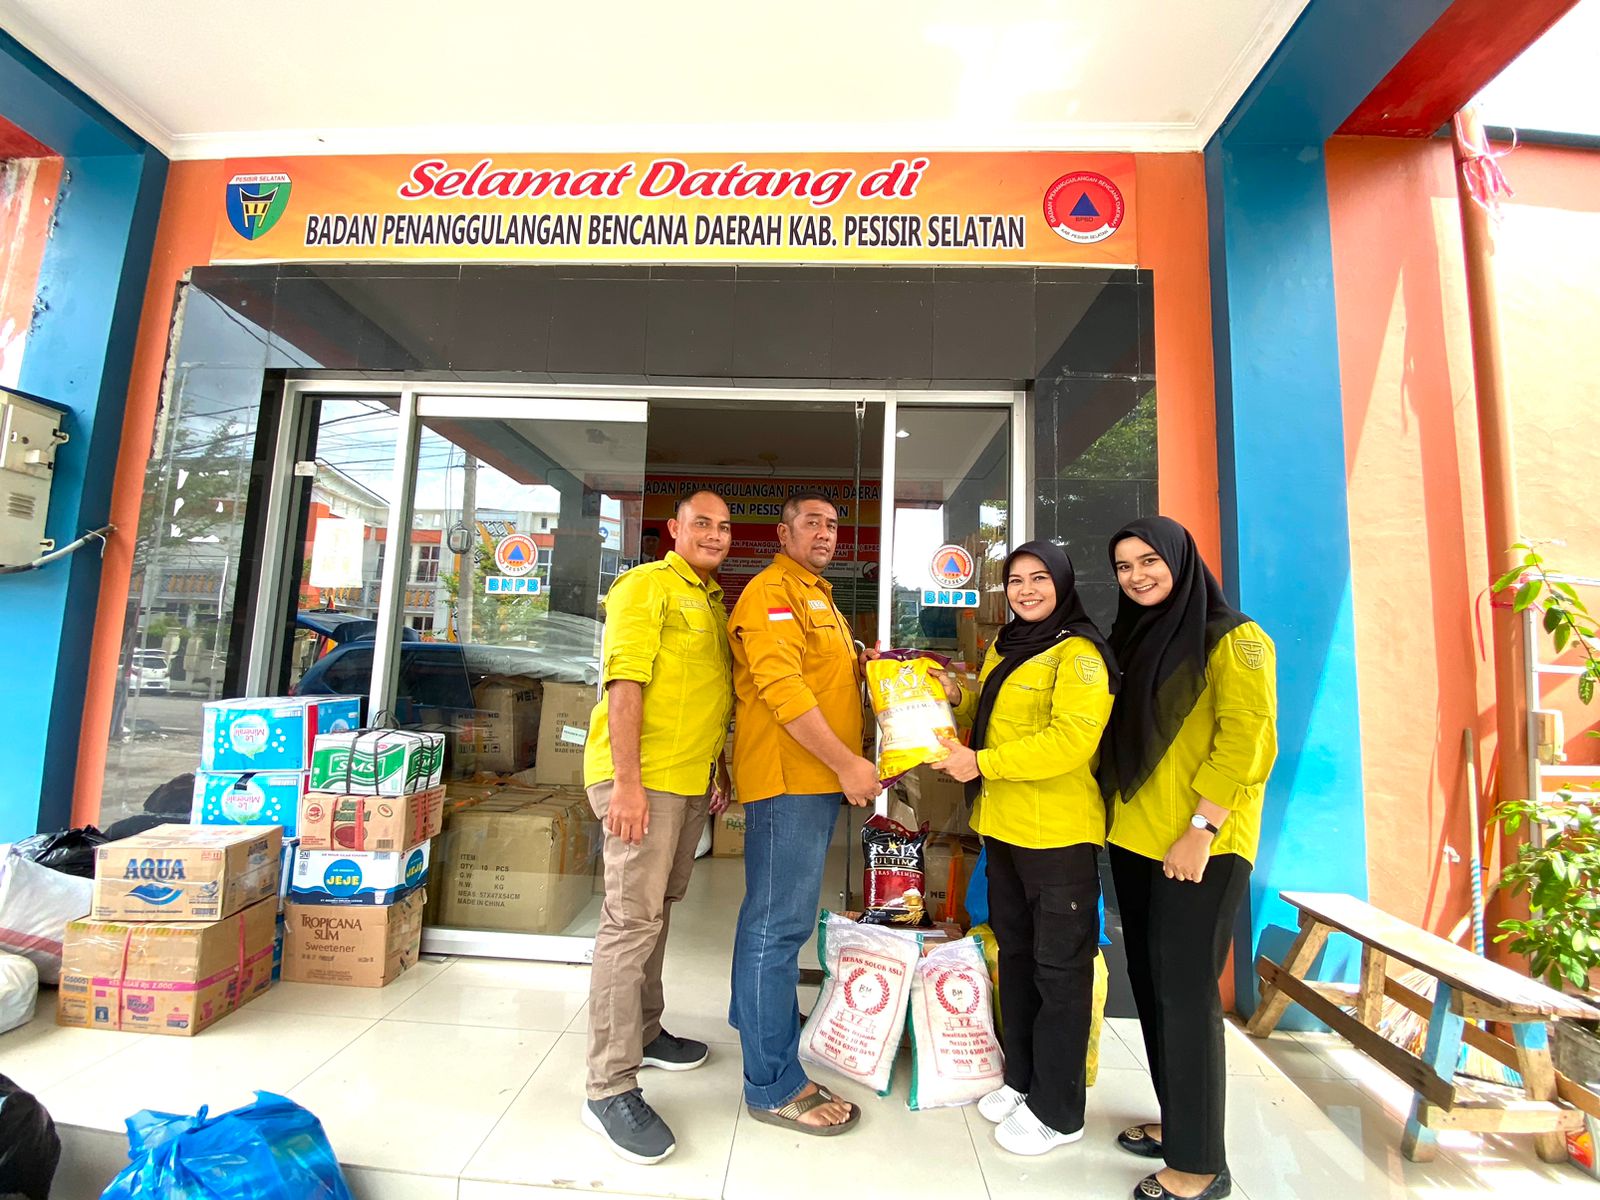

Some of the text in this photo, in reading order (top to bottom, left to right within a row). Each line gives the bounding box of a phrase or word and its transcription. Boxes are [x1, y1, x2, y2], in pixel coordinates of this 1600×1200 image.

[399, 158, 929, 205] Selamat Datang di
[306, 214, 1026, 249] BADAN PENANGGULANGAN BENCANA DAERAH KAB. PESISIR SELATAN
[643, 481, 676, 494] ADAN
[787, 485, 839, 499] BENNA
[842, 486, 881, 500] DAERA
[488, 578, 539, 592] BNPB
[924, 590, 977, 605] BNPB
[245, 735, 254, 743] Le
[871, 842, 922, 857] RAJA
[123, 857, 187, 881] AQUA
[406, 863, 423, 878] JEJE
[326, 875, 360, 886] JEJE
[300, 913, 363, 931] TROPICANA
[313, 928, 340, 941] SLIM
[304, 941, 356, 953] Sweetener
[841, 956, 903, 976] BERAS SOLOK ASLI
